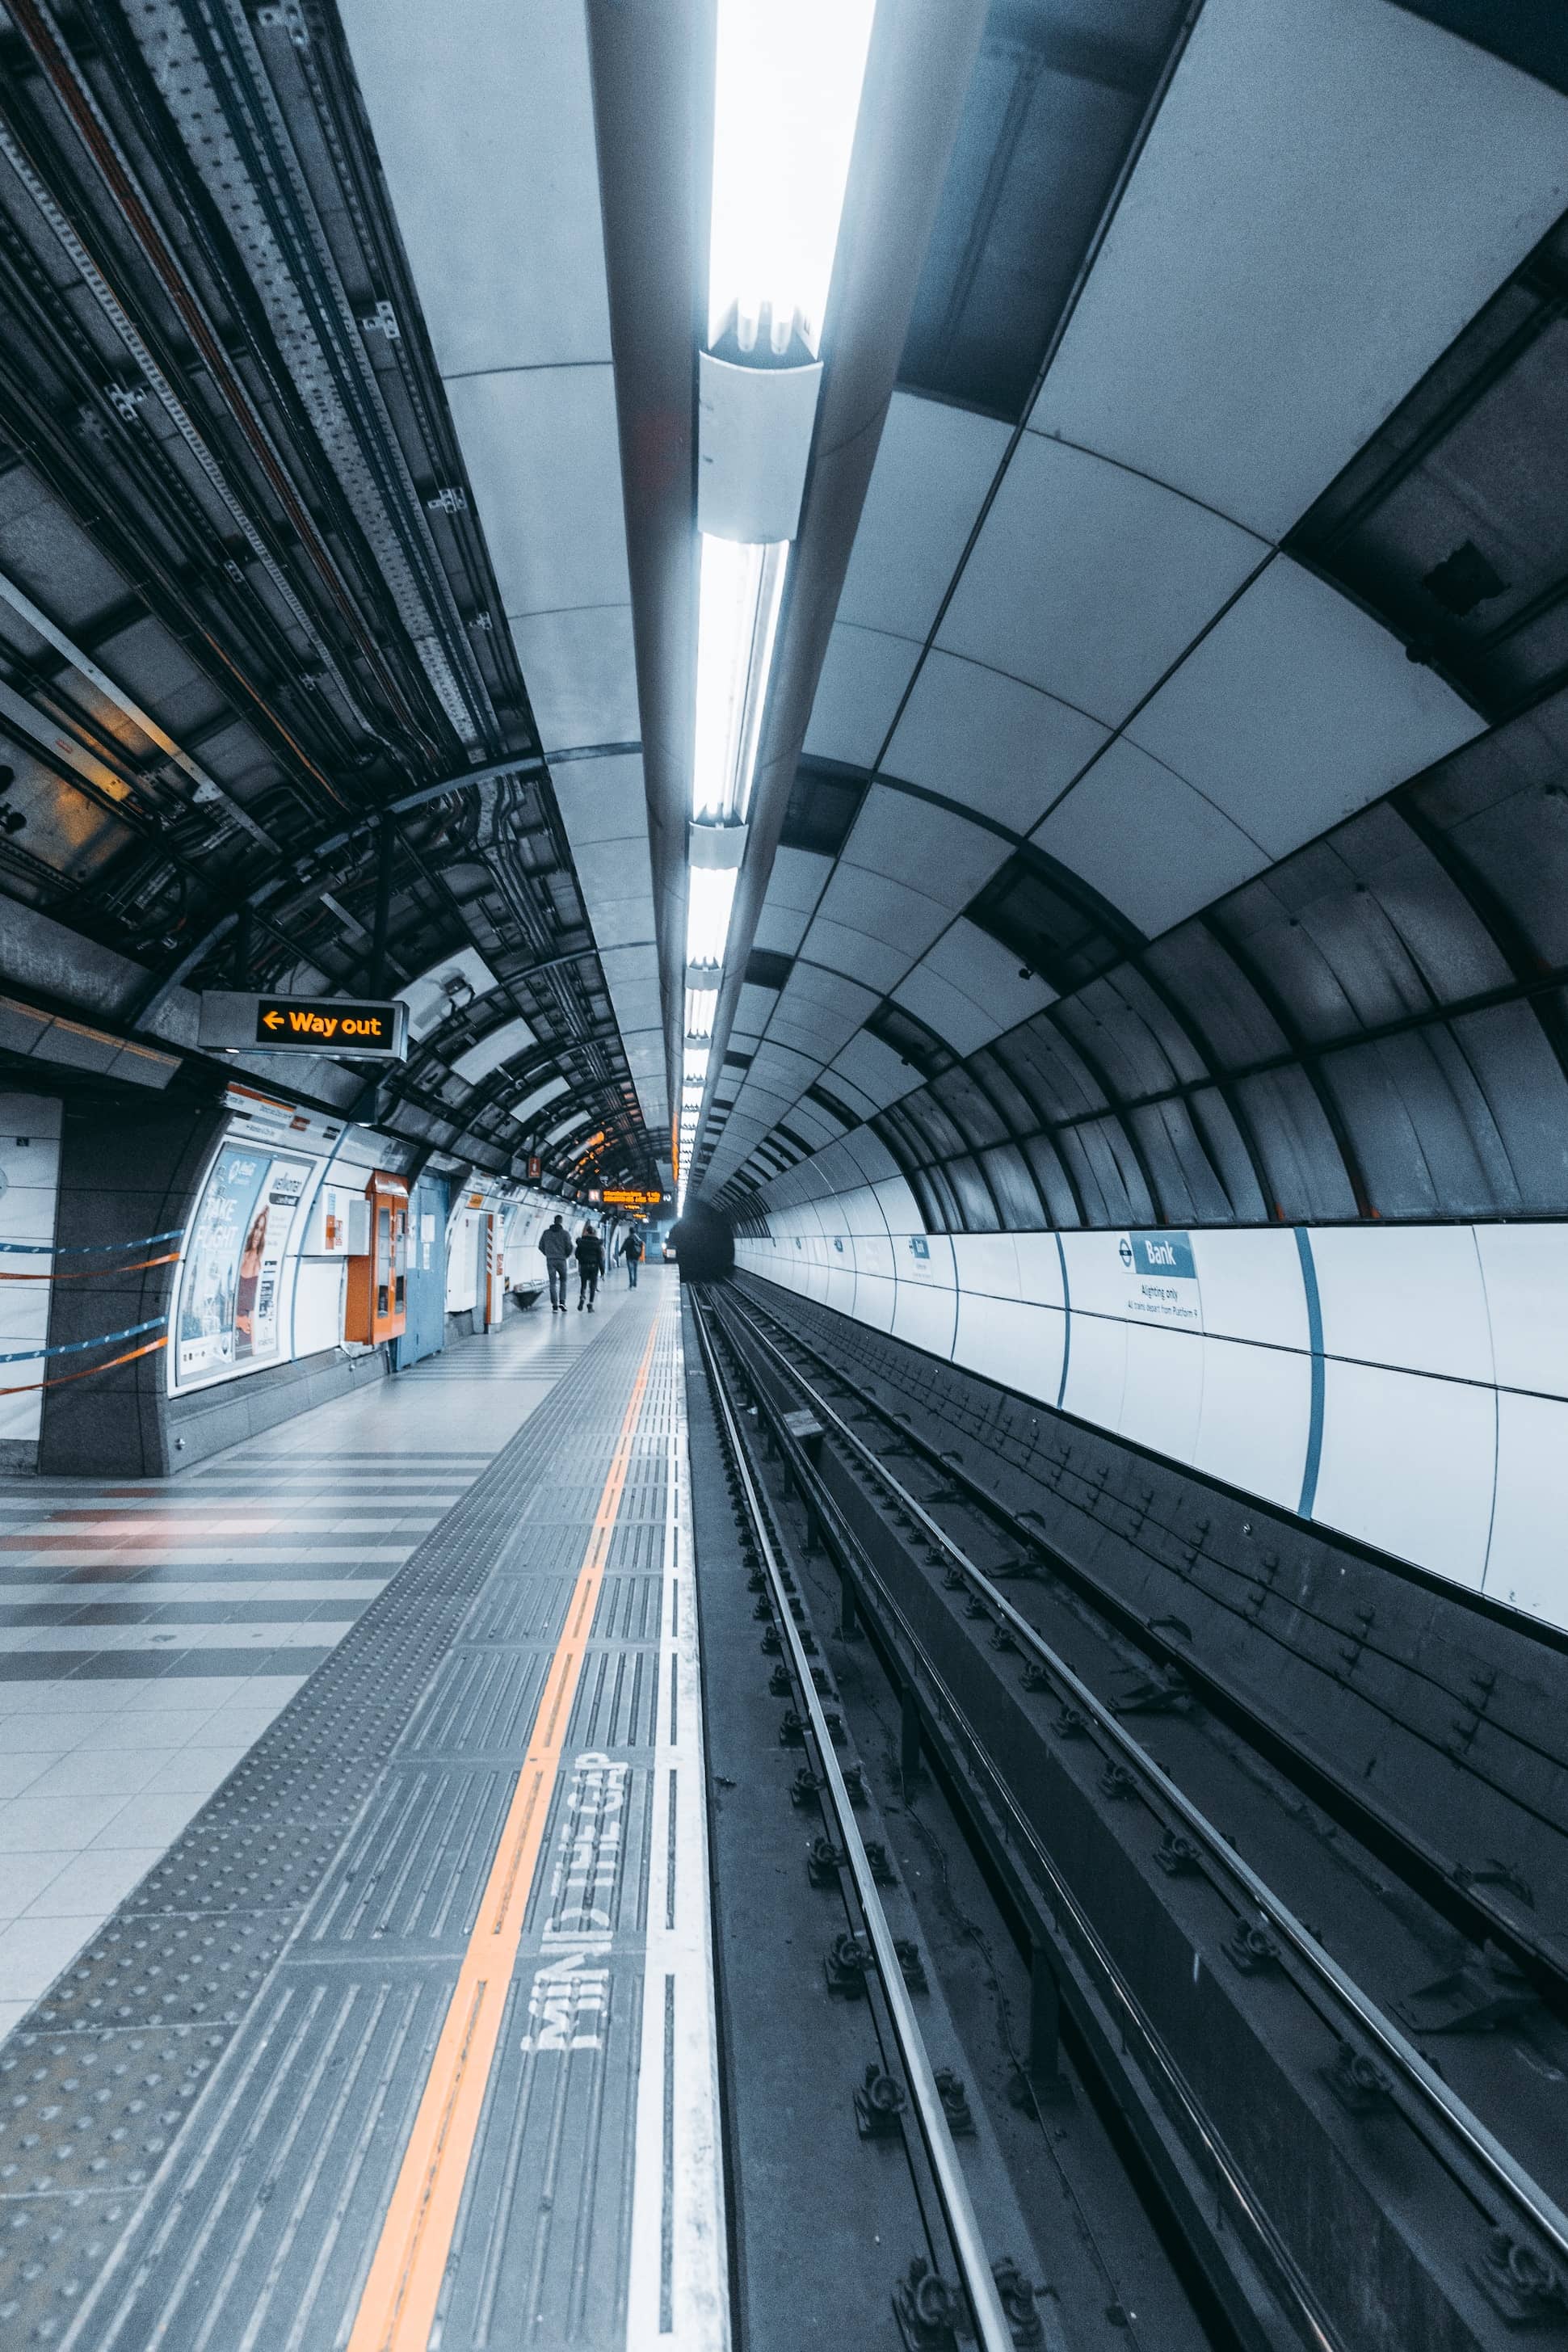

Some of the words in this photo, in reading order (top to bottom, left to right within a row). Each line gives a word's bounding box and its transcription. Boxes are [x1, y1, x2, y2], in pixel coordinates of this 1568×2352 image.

[288, 1012, 338, 1037] Way
[342, 1018, 381, 1036] out
[1145, 1240, 1176, 1265] Bank
[1167, 1288, 1178, 1302] only
[568, 1752, 628, 1813] GAP
[552, 1821, 621, 1896] THE
[520, 1908, 613, 2050] MIND
